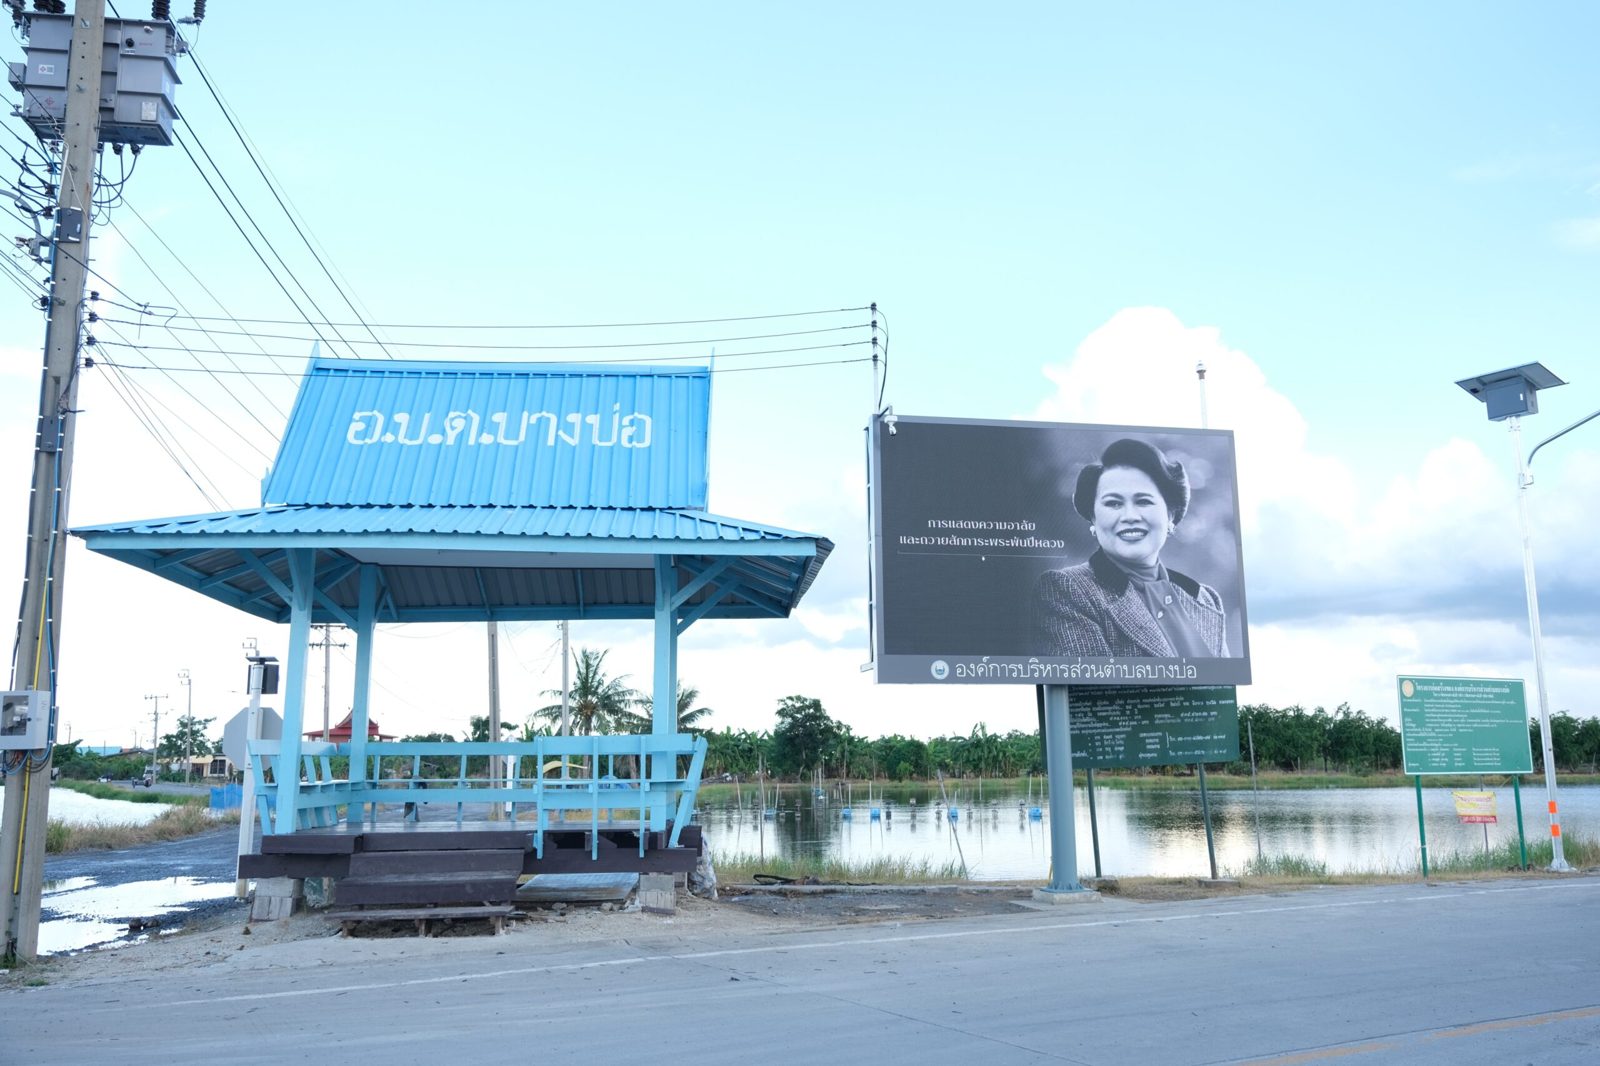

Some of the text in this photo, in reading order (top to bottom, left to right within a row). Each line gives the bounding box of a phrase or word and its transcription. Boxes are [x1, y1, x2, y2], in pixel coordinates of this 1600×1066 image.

[347, 402, 652, 448] อ.บ.ต.บางบ่อ
[927, 518, 1036, 531] การแสดงความอาลัย
[899, 534, 1065, 548] และถวายสักการะพระพันปีหลวง
[956, 656, 1197, 679] องค์การบริหารส่วนตำบลบางบ่อ
